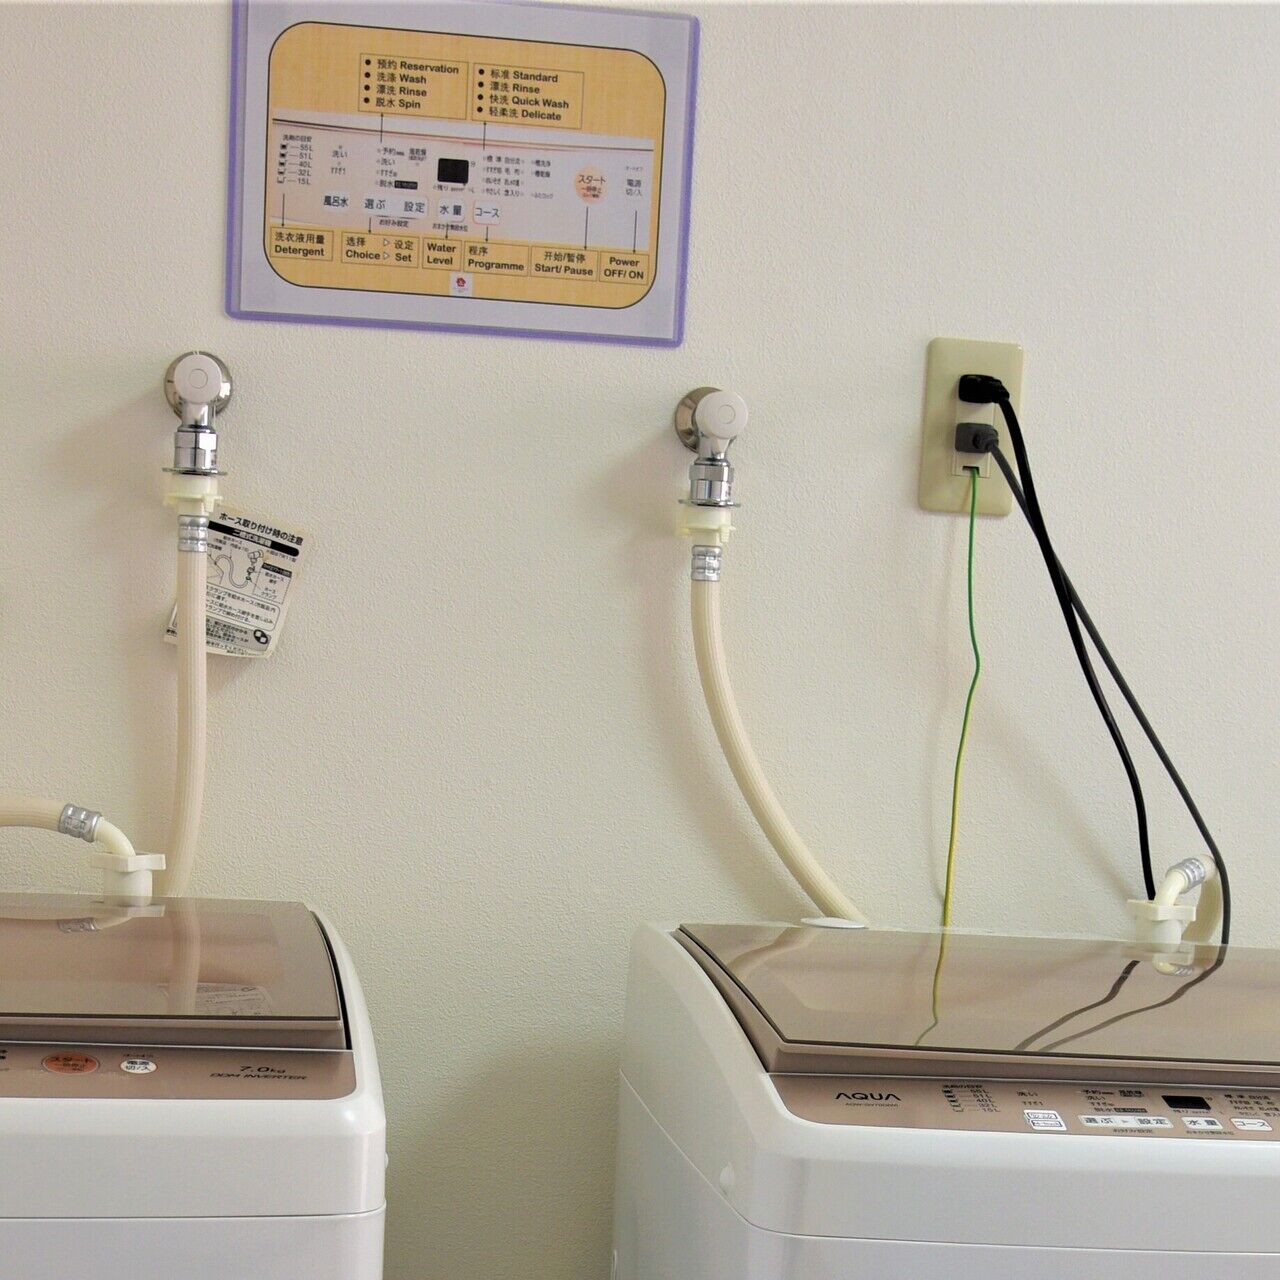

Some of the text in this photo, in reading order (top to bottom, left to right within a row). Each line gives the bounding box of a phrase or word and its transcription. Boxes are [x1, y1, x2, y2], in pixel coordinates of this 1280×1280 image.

[400, 61, 459, 74] Reservation
[400, 74, 426, 84] Wash
[513, 71, 558, 82] Standard
[400, 86, 426, 96] Rinse
[512, 84, 540, 94] Rinse
[399, 99, 420, 110] Spin
[490, 94, 569, 109] 快洗 Quick Wash
[490, 107, 561, 120] 轻柔洗 Delicate
[578, 174, 606, 184] スタート
[324, 196, 348, 207] 風呂水
[365, 198, 386, 209] 選ぶ
[404, 202, 425, 213] 設定
[440, 204, 462, 216] 水量
[476, 208, 499, 218] コース
[275, 232, 324, 244] 洗衣液用量
[346, 236, 414, 250] 选择 设定
[274, 245, 324, 257] Detergent
[427, 243, 456, 252] Water
[469, 246, 488, 256] 程序
[346, 250, 412, 262] Choice Set
[427, 256, 452, 264] Level
[544, 251, 586, 263] 开始/暂停
[610, 257, 640, 266] Power
[468, 259, 524, 270] Programme
[564, 266, 593, 276] Pause
[604, 268, 644, 280] OFF/ ON
[219, 512, 303, 545] ホース取り付け時の注意
[240, 1066, 286, 1074] 7.0kg
[836, 1092, 901, 1100] AQUA
